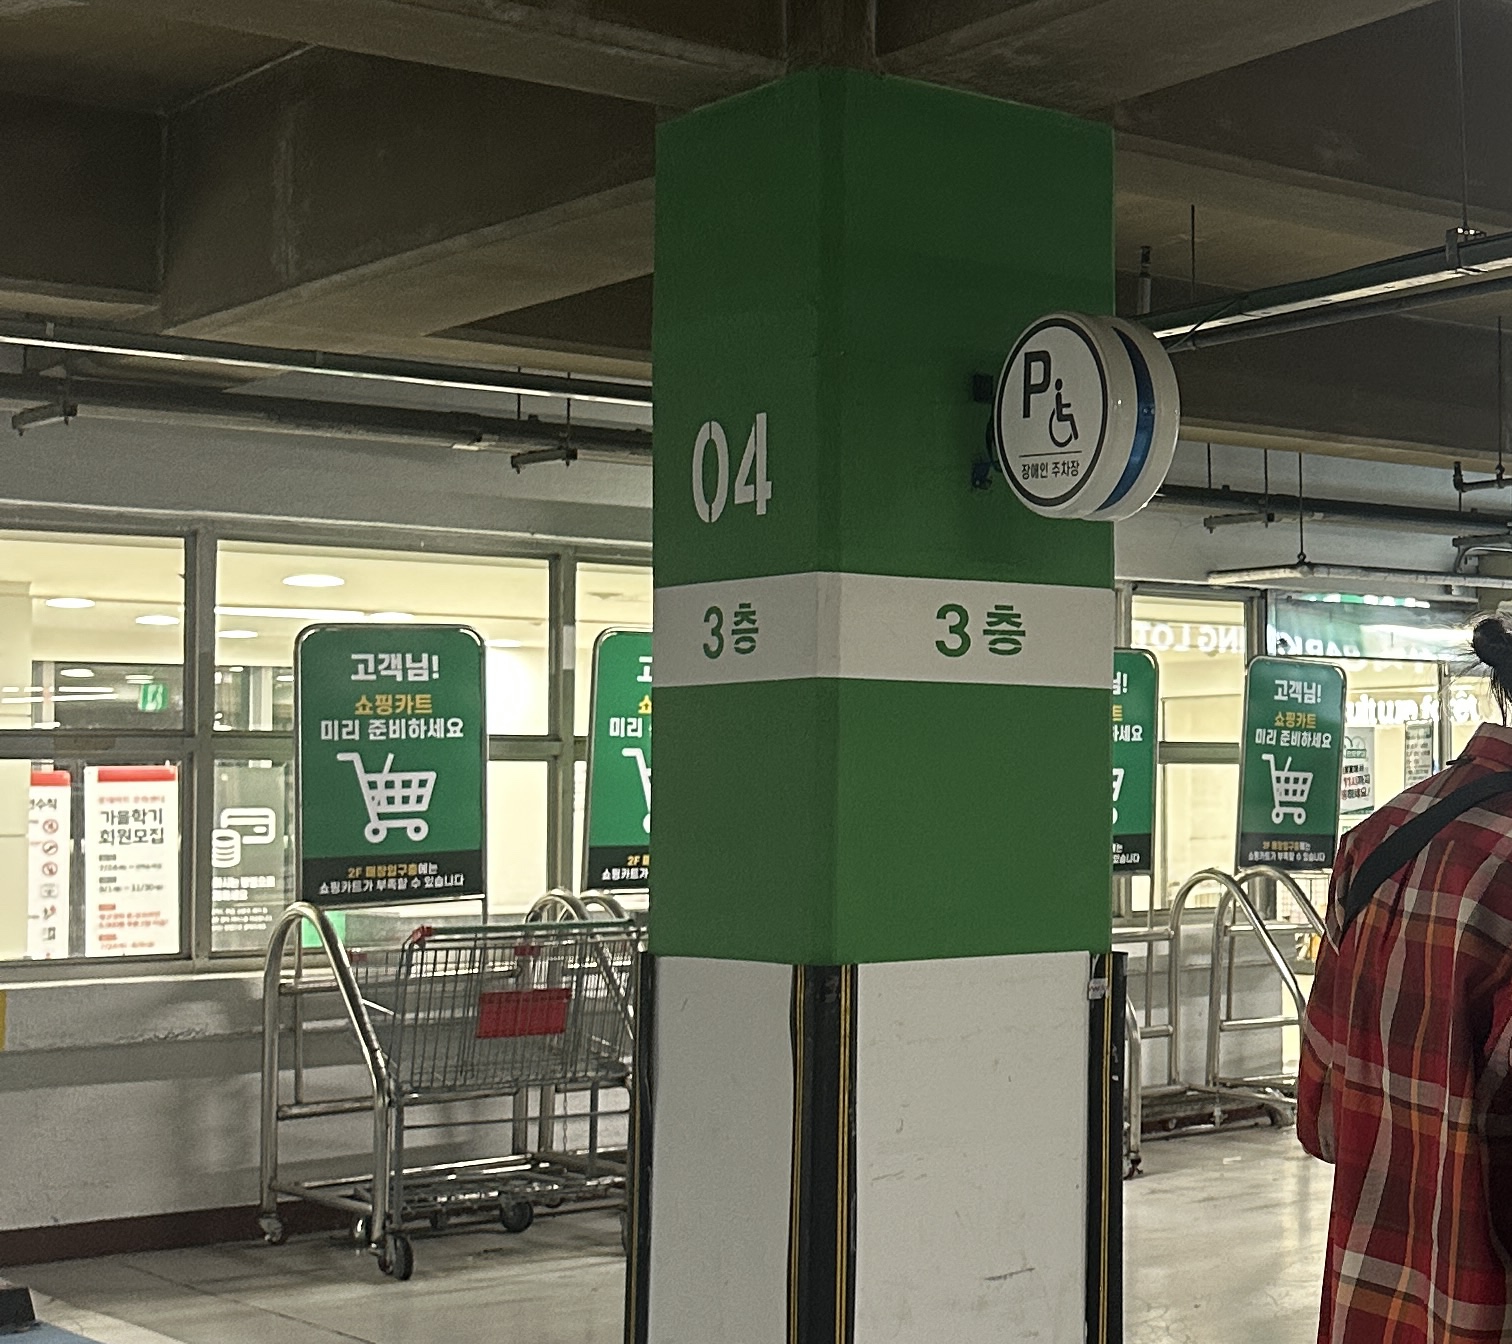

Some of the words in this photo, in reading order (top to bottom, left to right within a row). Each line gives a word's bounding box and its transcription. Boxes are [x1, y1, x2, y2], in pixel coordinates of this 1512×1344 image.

[1022, 350, 1052, 419] P
[692, 412, 773, 523] 04
[1021, 462, 1049, 480] 장애인
[1051, 460, 1080, 478] 주차장
[350, 653, 440, 682] 고객님!
[1273, 679, 1322, 704] 고객님!
[354, 693, 433, 716] 쇼핑카트
[320, 719, 360, 741] 미리
[368, 717, 464, 740] 준비하세요
[608, 716, 643, 738] 미리
[1274, 711, 1317, 729] 쇼핑카트
[1255, 728, 1277, 745] 미리
[1280, 730, 1332, 748] 준비하세요
[100, 808, 162, 826] 가을학기
[99, 827, 163, 846] 회원모집
